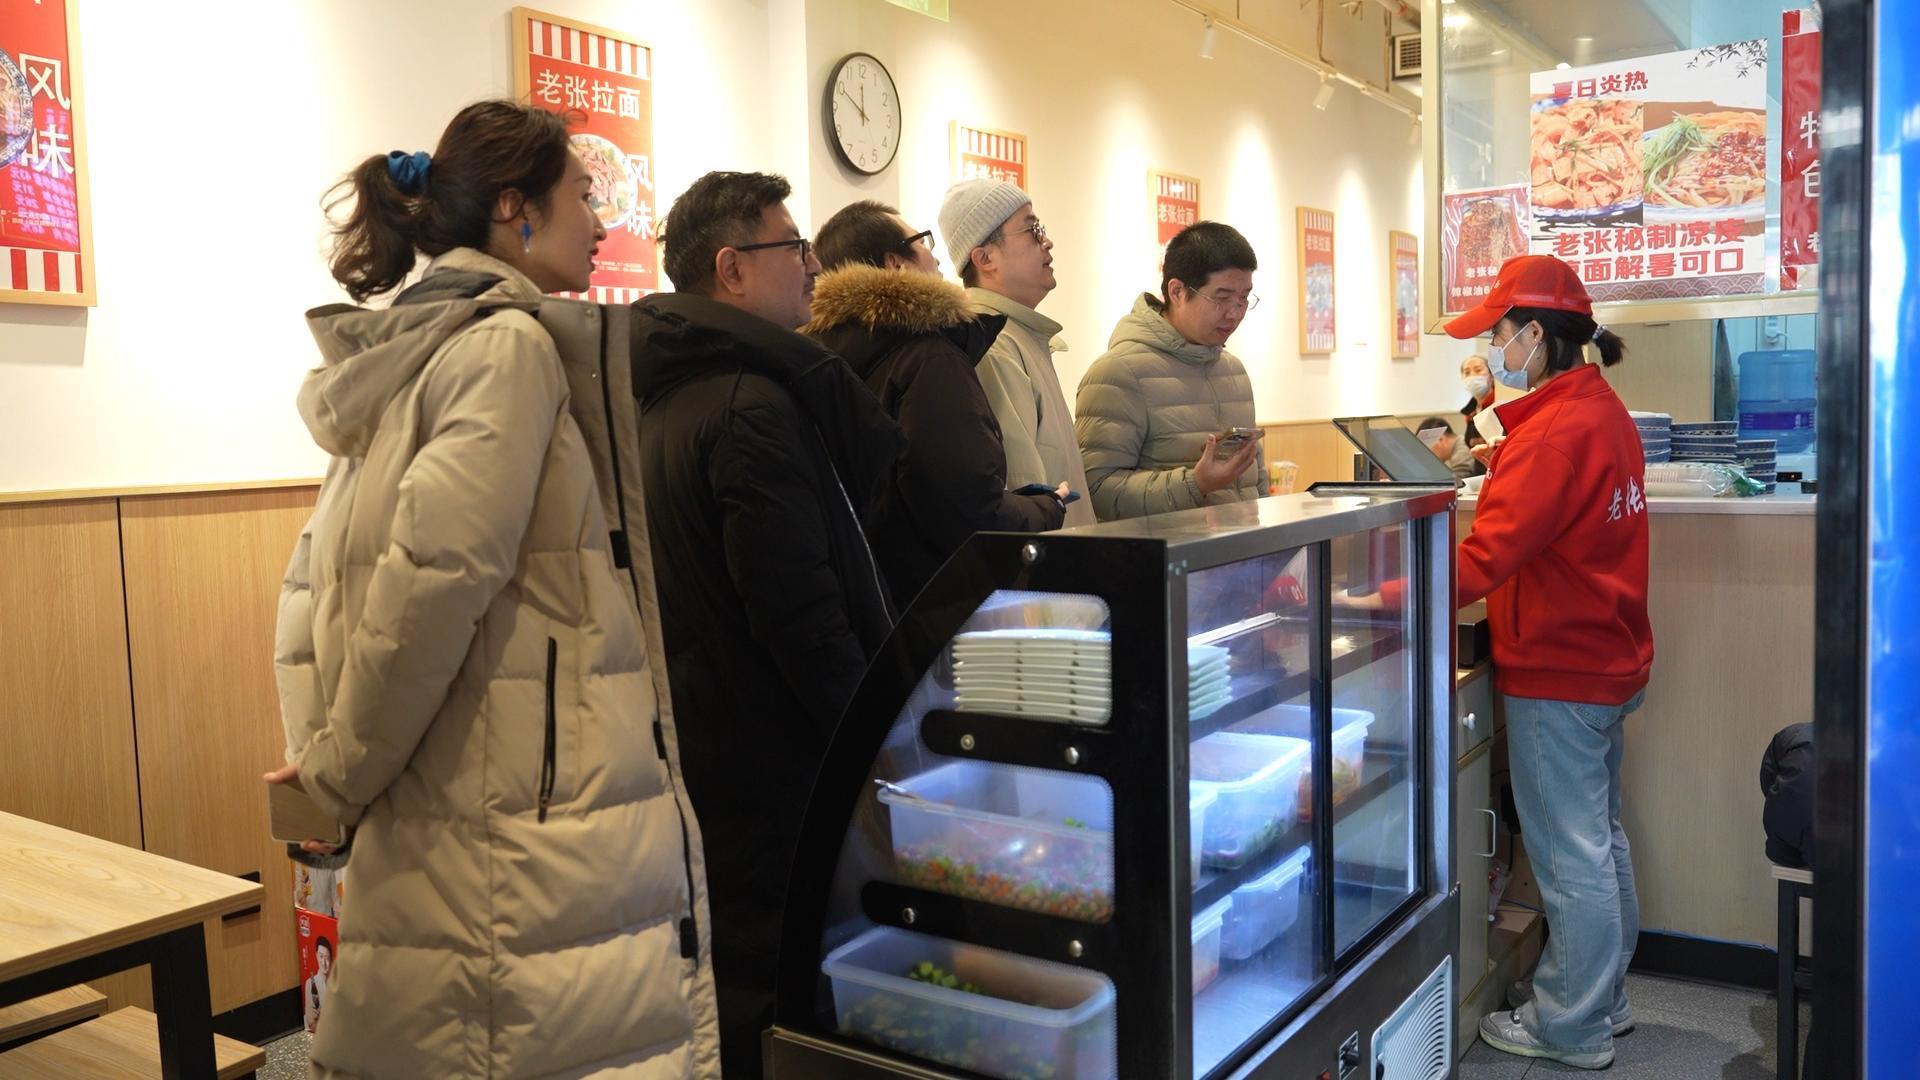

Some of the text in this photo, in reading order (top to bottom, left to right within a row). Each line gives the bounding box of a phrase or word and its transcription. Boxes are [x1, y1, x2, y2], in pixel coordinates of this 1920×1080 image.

[846, 65, 853, 80] 11
[858, 63, 867, 79] 12
[1552, 70, 1649, 100] 夏日炎热
[537, 69, 640, 120] 老张拉面
[882, 92, 888, 107] 2
[19, 53, 74, 178] 风味
[886, 114, 892, 129] 3
[847, 143, 853, 156] 7
[882, 136, 888, 148] 4
[859, 153, 865, 167] 6
[872, 149, 878, 163] 5
[624, 154, 655, 240] 风味
[1552, 218, 1746, 257] 老张秘制凉皮
